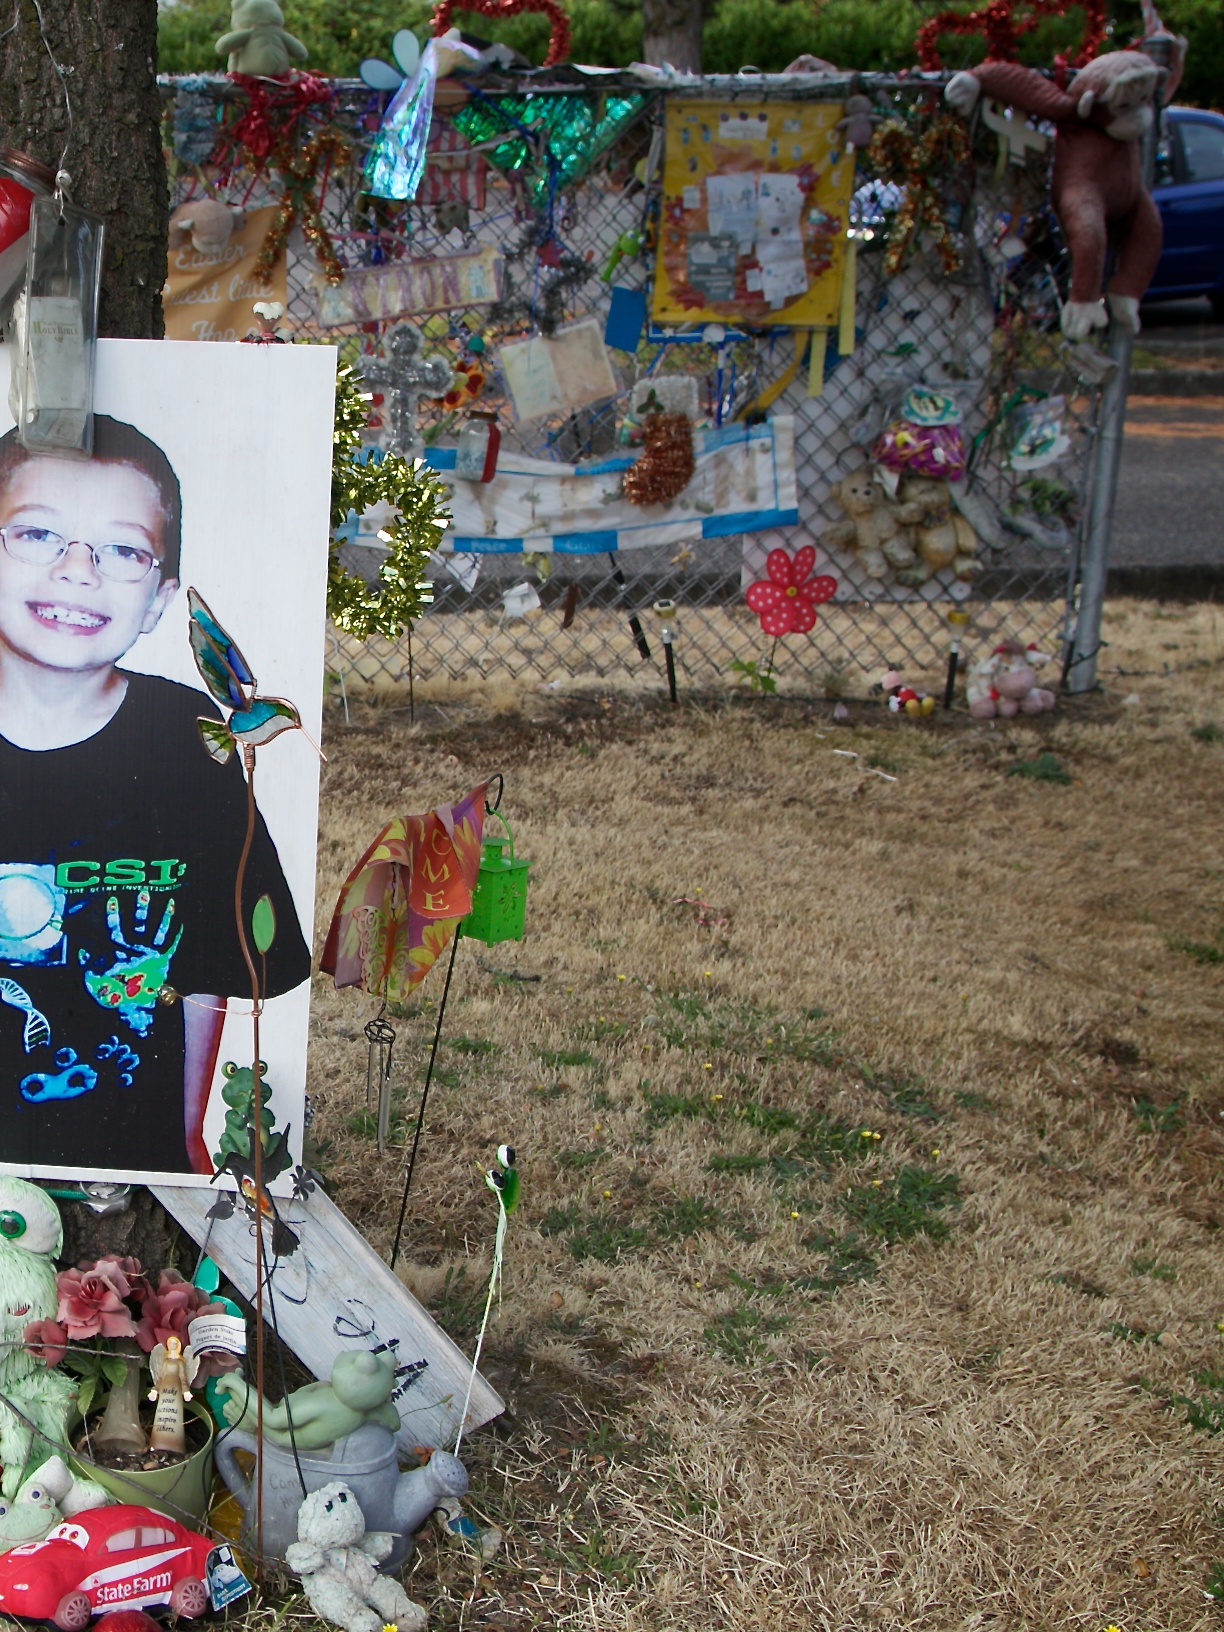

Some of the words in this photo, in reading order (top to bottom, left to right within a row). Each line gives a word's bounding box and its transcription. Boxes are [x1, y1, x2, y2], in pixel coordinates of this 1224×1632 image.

[33, 321, 56, 334] HOLY
[57, 326, 78, 335] BIBLE
[220, 1327, 234, 1335] Stake
[222, 1336, 237, 1345] jardin
[162, 1388, 178, 1396] Make
[269, 1472, 300, 1490] Com
[96, 1583, 132, 1604] State
[132, 1570, 172, 1595] Farm
